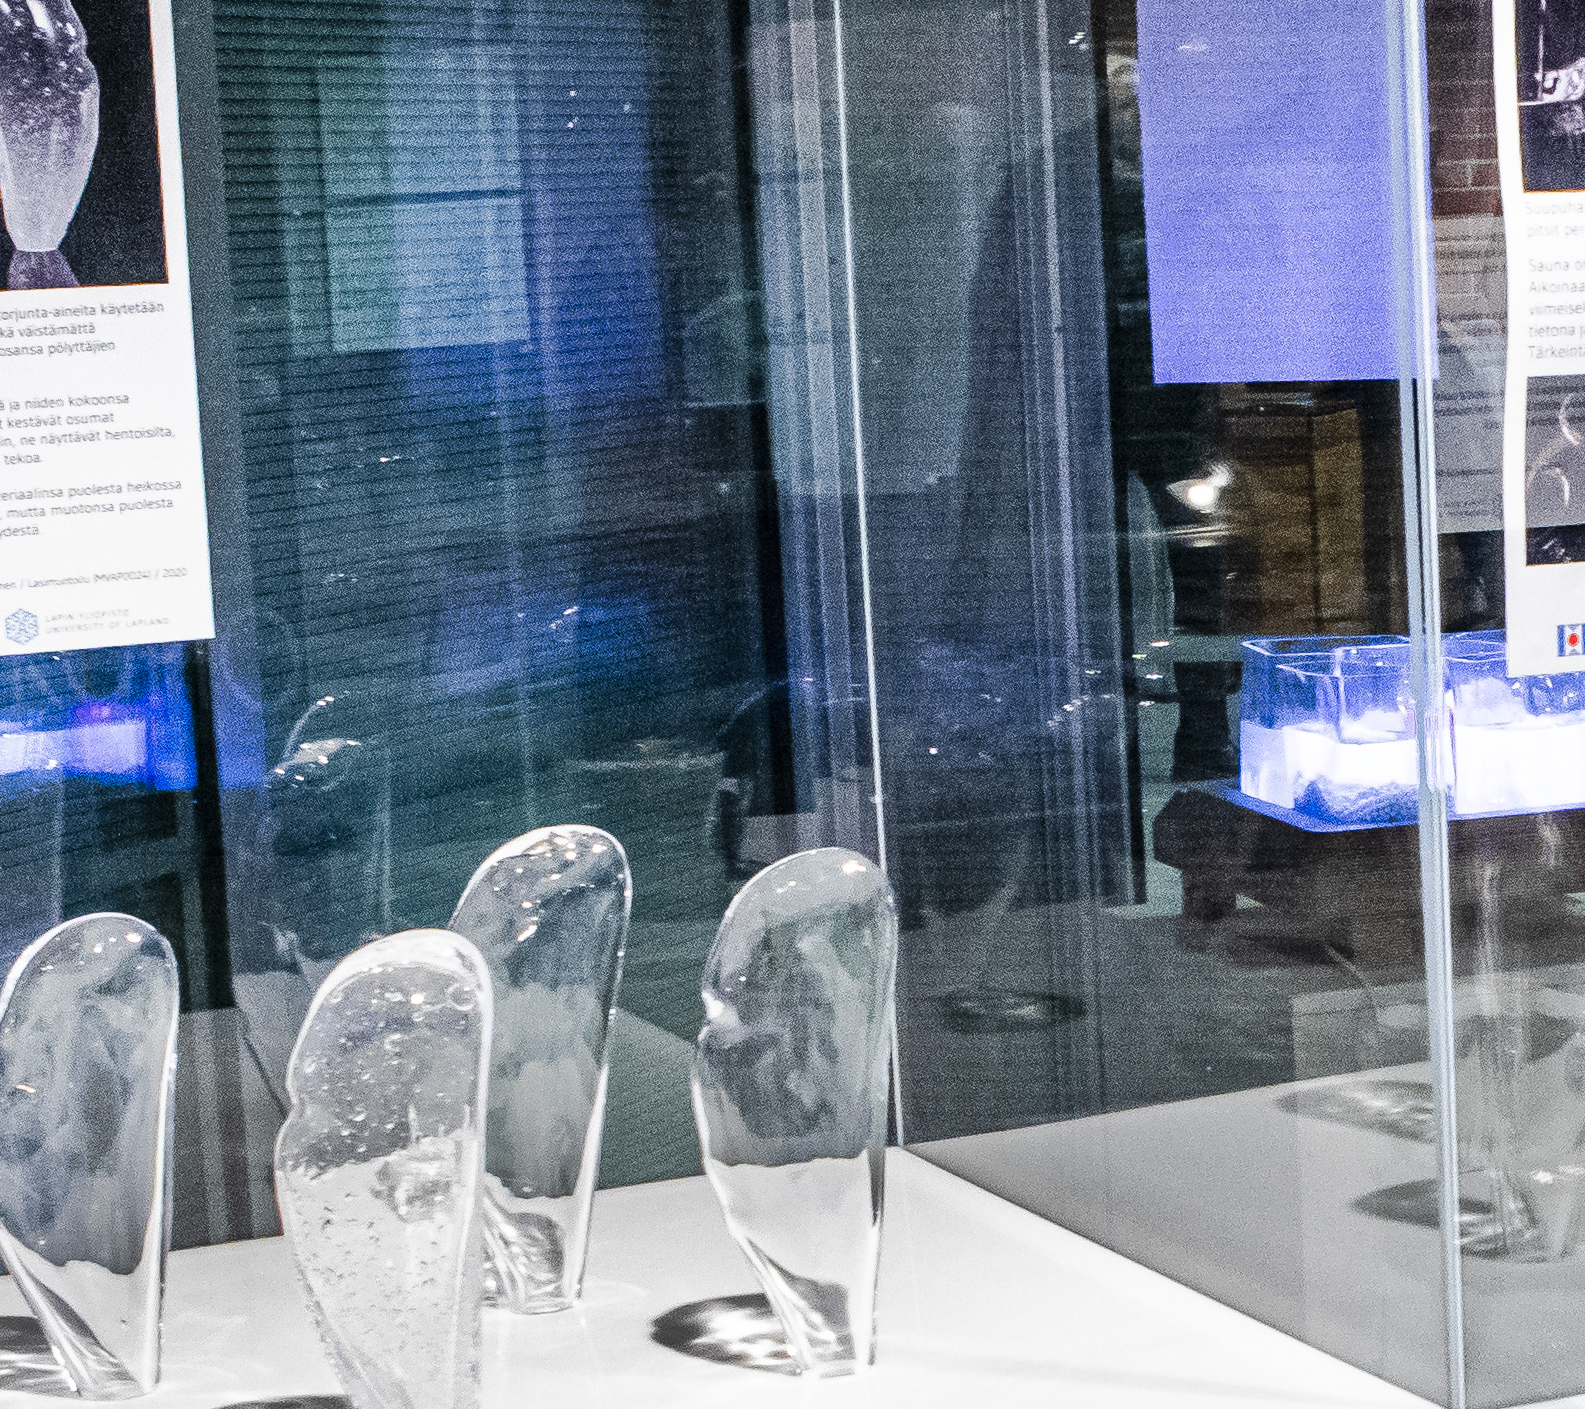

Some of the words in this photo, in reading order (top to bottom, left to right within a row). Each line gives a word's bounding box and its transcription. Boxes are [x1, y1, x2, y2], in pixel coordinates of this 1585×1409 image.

[1525, 221, 1560, 240] pitsit
[1528, 258, 1571, 272] Sauna
[99, 299, 165, 318] käytetään
[17, 320, 97, 338] väistämättä
[1527, 322, 1577, 338] tietona
[47, 338, 116, 358] pölyttäjien
[8, 397, 21, 414] ja
[24, 395, 65, 409] niiden
[67, 393, 131, 407] kokoonsa
[6, 413, 62, 429] kestävät
[65, 409, 115, 425] osumat
[19, 436, 37, 446] ne
[39, 428, 101, 448] näyttävät
[67, 481, 124, 500] puolesta
[126, 478, 183, 493] heikossa
[6, 504, 47, 519] mutta
[50, 501, 116, 516] muotonsa
[118, 495, 174, 515] puolesta
